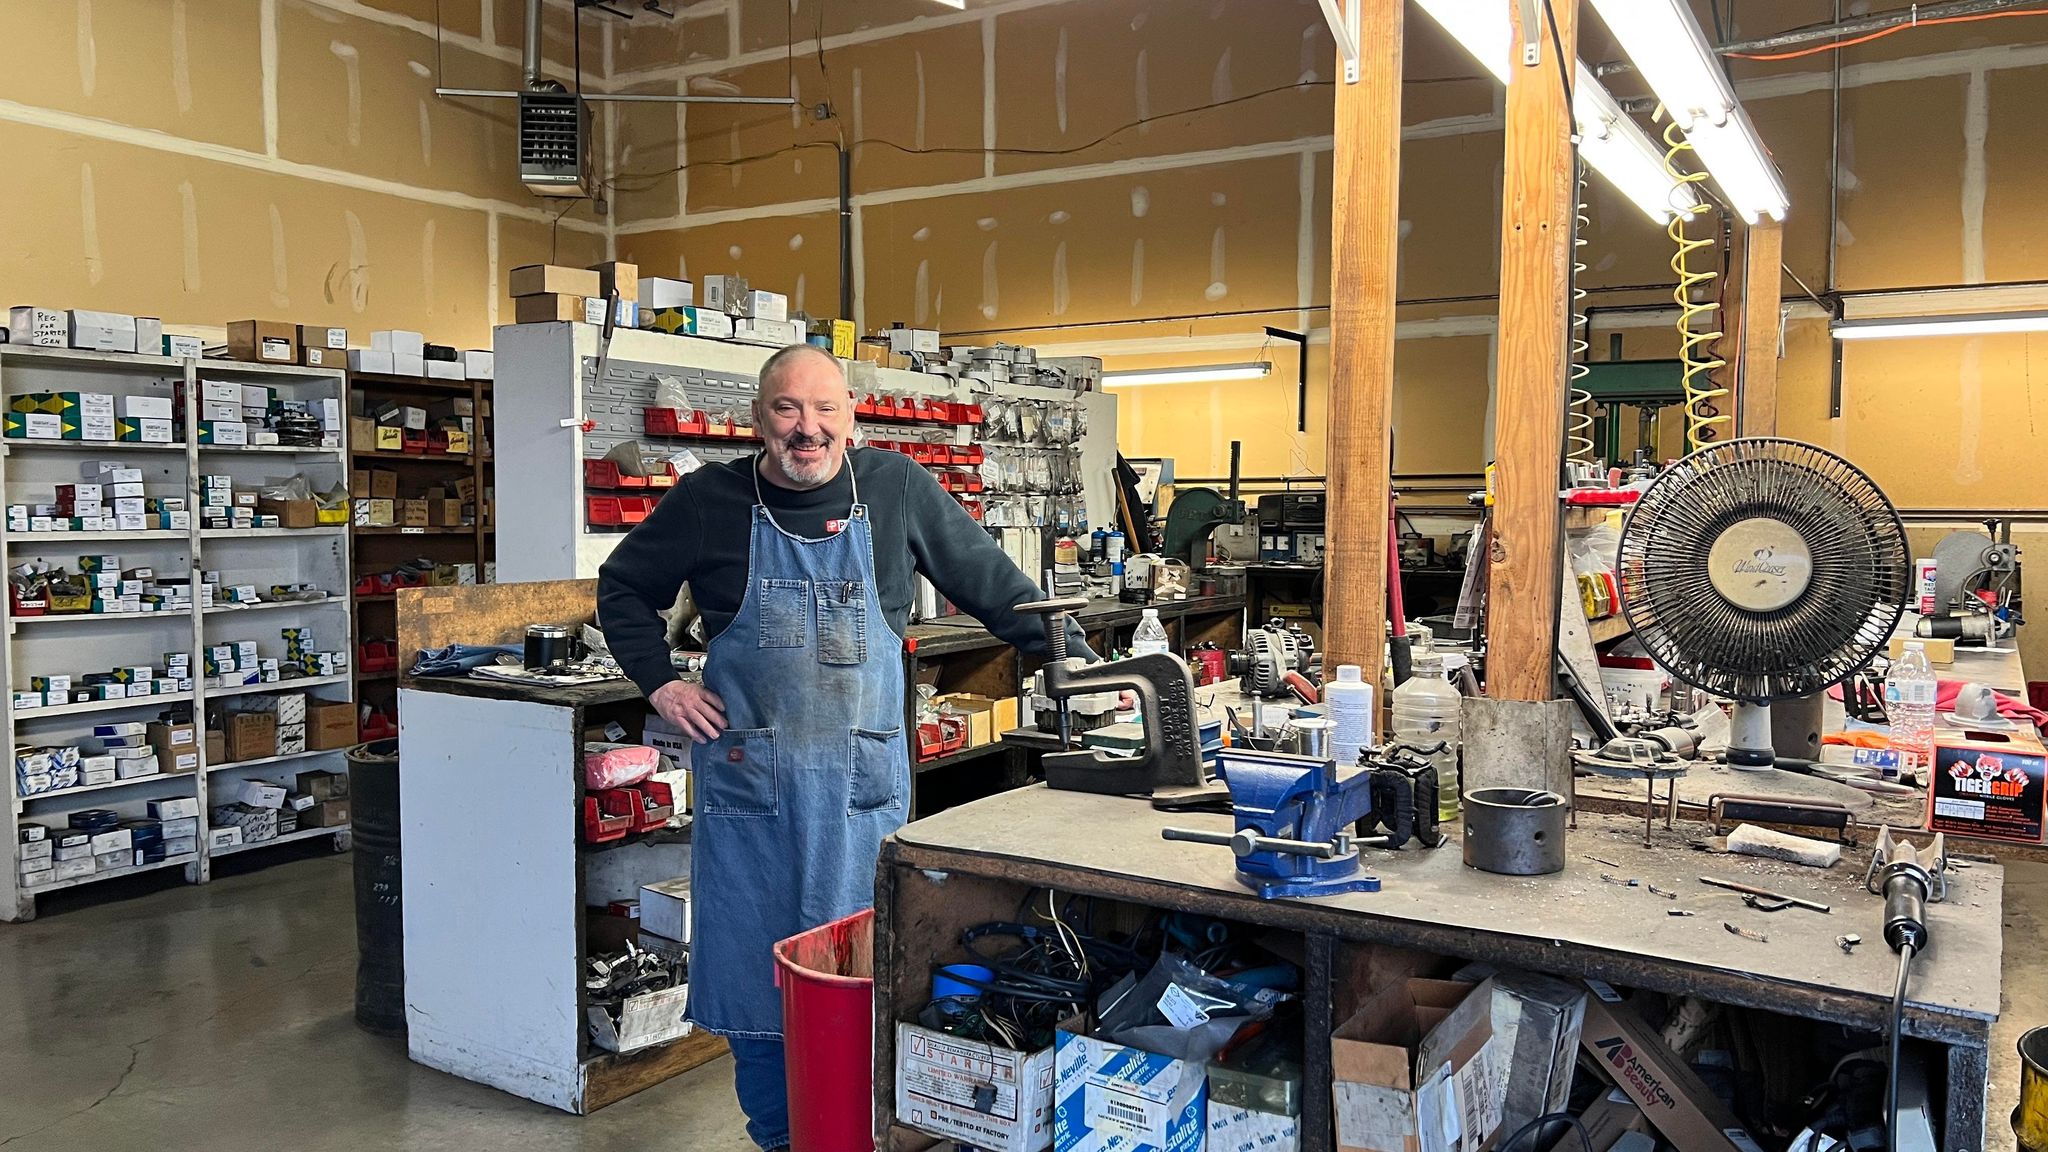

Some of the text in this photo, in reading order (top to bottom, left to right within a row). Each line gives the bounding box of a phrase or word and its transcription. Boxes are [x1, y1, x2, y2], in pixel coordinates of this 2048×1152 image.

[33, 330, 67, 338] STARTER
[41, 337, 60, 345] GEN
[1159, 695, 1175, 742] COAST
[927, 1048, 1013, 1079] STARTER
[1055, 1053, 1088, 1090] e-Neville
[1623, 1065, 1660, 1107] Beauty
[1627, 1056, 1676, 1110] American
[975, 1125, 982, 1133] AT
[982, 1127, 1010, 1140] FACTORY
